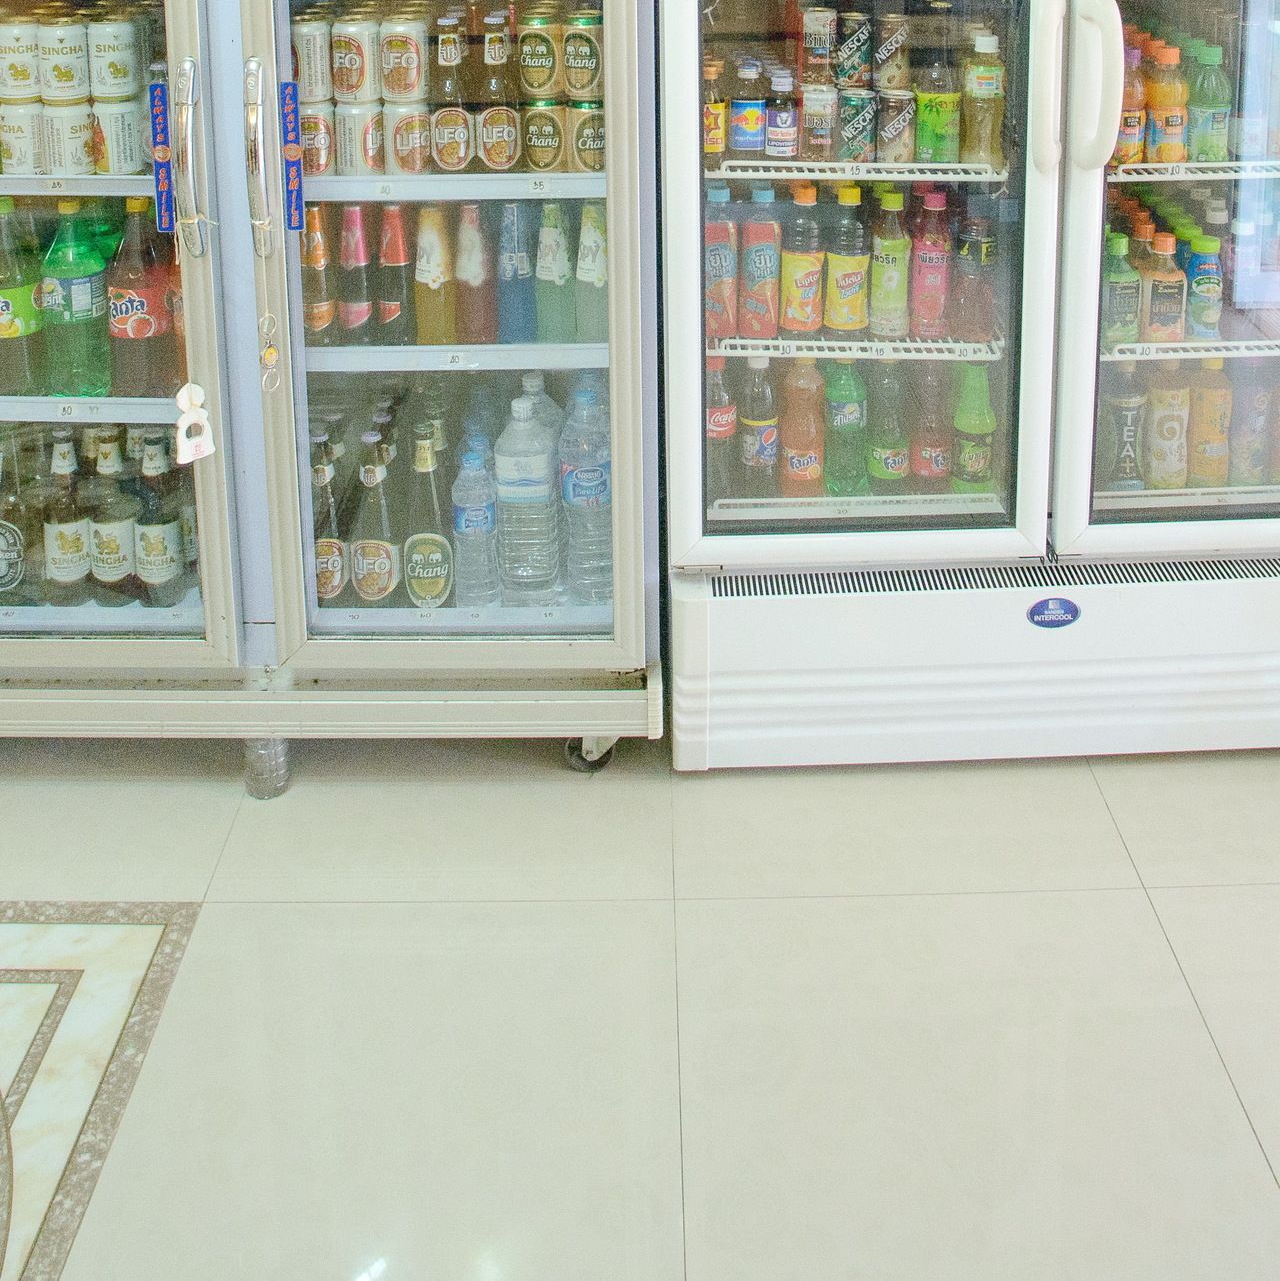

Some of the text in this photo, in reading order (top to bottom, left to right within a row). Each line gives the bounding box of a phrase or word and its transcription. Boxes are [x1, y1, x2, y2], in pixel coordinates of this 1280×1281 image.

[41, 44, 83, 57] SINGHA
[520, 54, 553, 68] Chang
[564, 56, 597, 70] Chang
[435, 126, 468, 143] LEO
[482, 124, 517, 142] LEO
[525, 135, 559, 149] Chang
[153, 87, 173, 229] ALWAYS SMILE
[283, 85, 301, 229] ALWAYS SMILE
[850, 165, 862, 176] 15
[874, 347, 885, 357] 15
[407, 562, 449, 578] Chang
[1033, 613, 1074, 623] INTERCOOL
